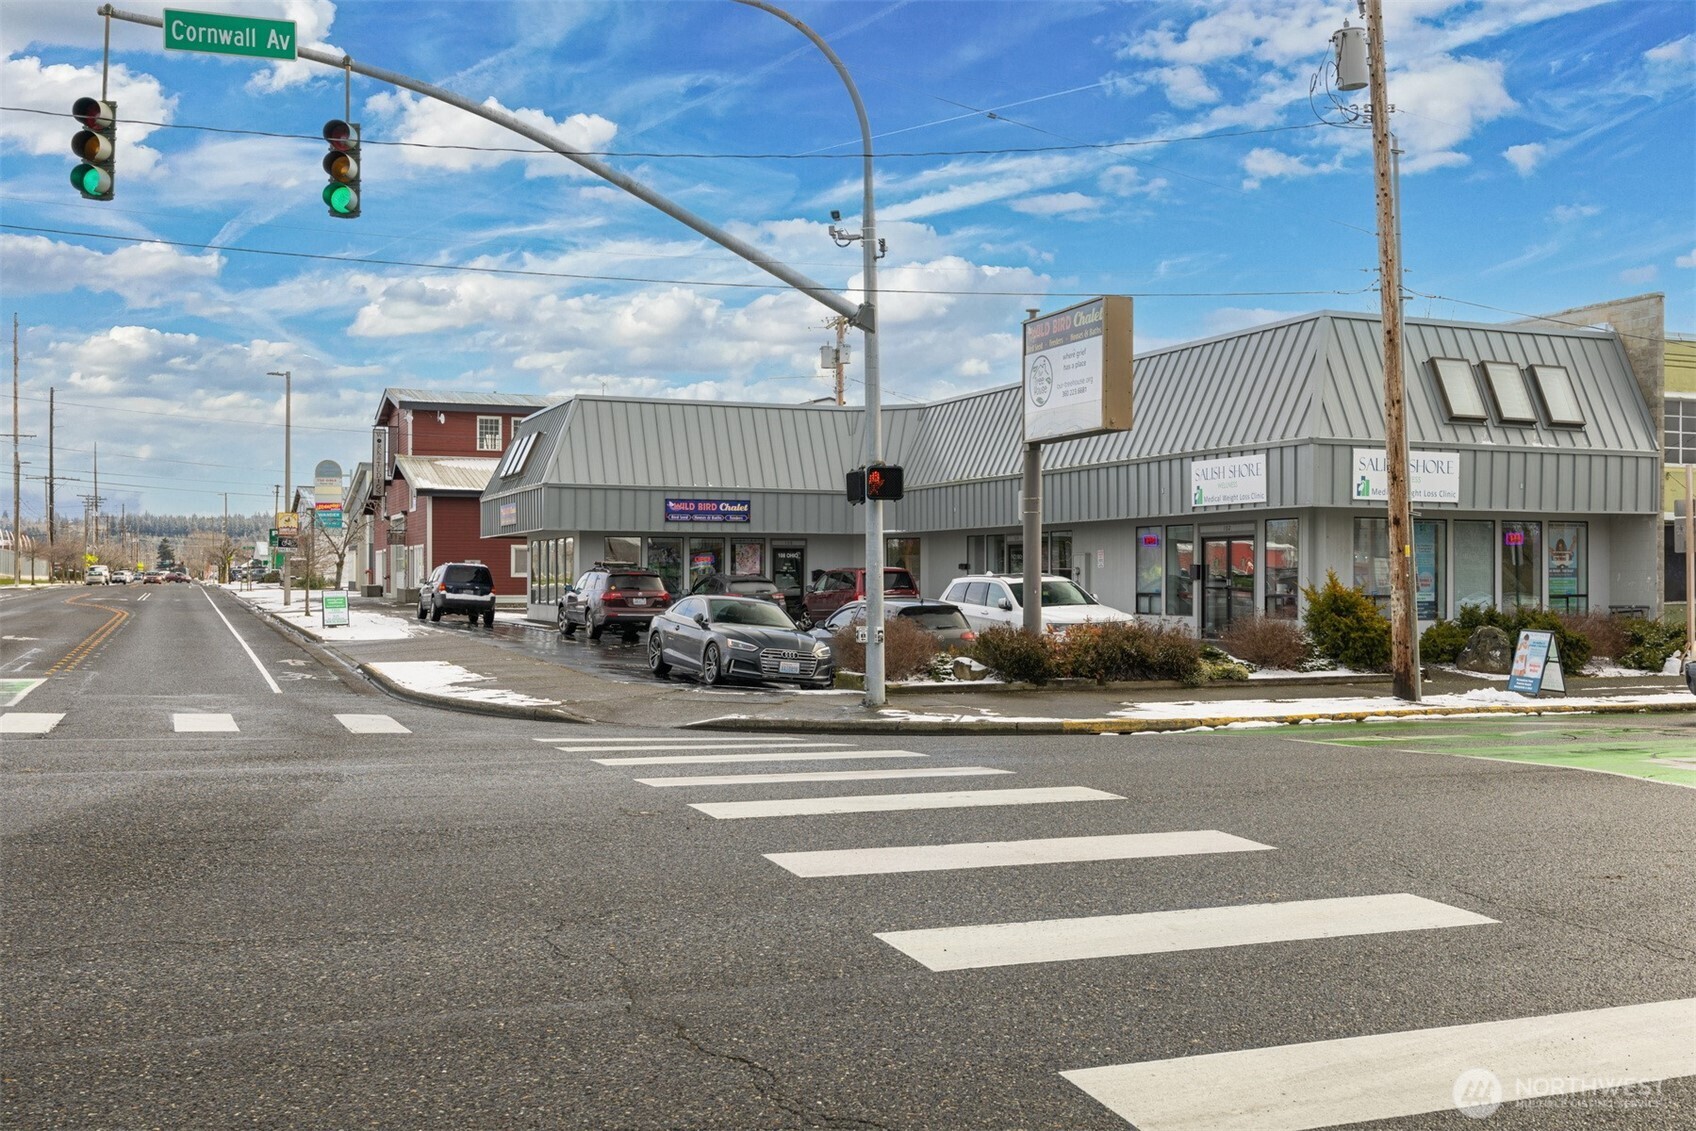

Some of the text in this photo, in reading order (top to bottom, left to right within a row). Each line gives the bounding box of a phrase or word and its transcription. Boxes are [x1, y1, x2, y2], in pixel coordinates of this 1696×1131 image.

[171, 19, 290, 51] Cornwall Av
[1052, 316, 1072, 334] BIRD
[1073, 306, 1103, 327] Chalet
[1062, 347, 1087, 360] where grief
[1063, 363, 1071, 371] has
[1075, 360, 1087, 370] place
[1194, 462, 1262, 481] SALISH SHORE
[1409, 459, 1455, 475] SHORE
[1216, 480, 1239, 489] WELLNESS
[1204, 489, 1265, 503] Medical Weight Loss Clinic
[1423, 489, 1438, 498] Loss
[1438, 489, 1457, 499] Clinic
[672, 502, 748, 511] WILD BIRD Chalet
